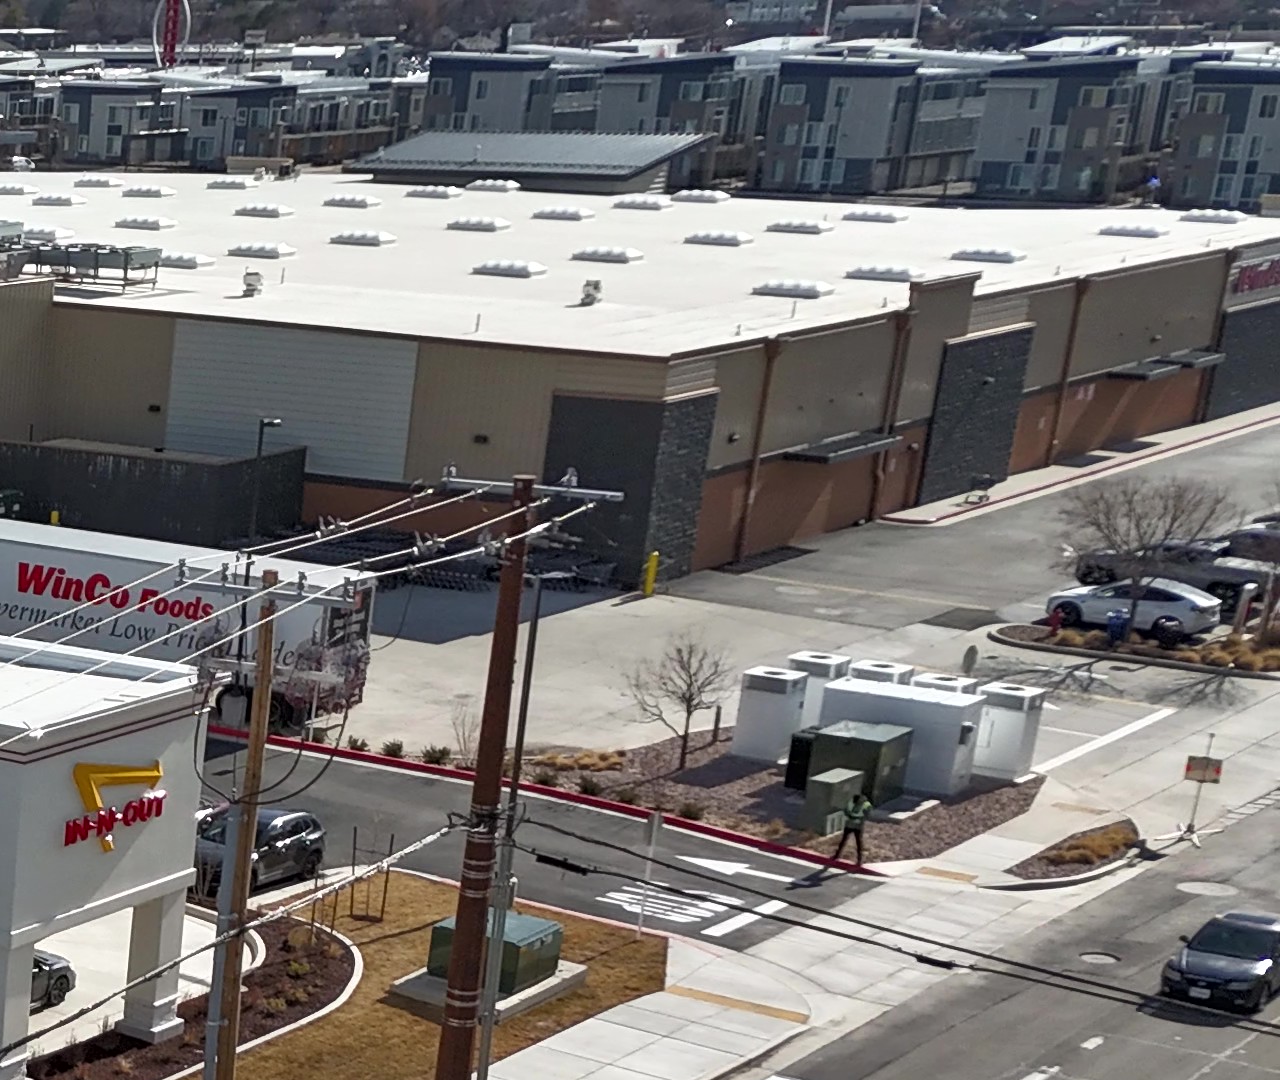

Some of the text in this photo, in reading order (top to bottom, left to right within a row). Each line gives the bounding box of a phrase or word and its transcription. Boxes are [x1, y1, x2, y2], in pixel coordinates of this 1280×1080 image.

[17, 561, 215, 623] WinCo Foods
[109, 618, 156, 643] Low
[64, 790, 167, 846] IN-N-OUT
